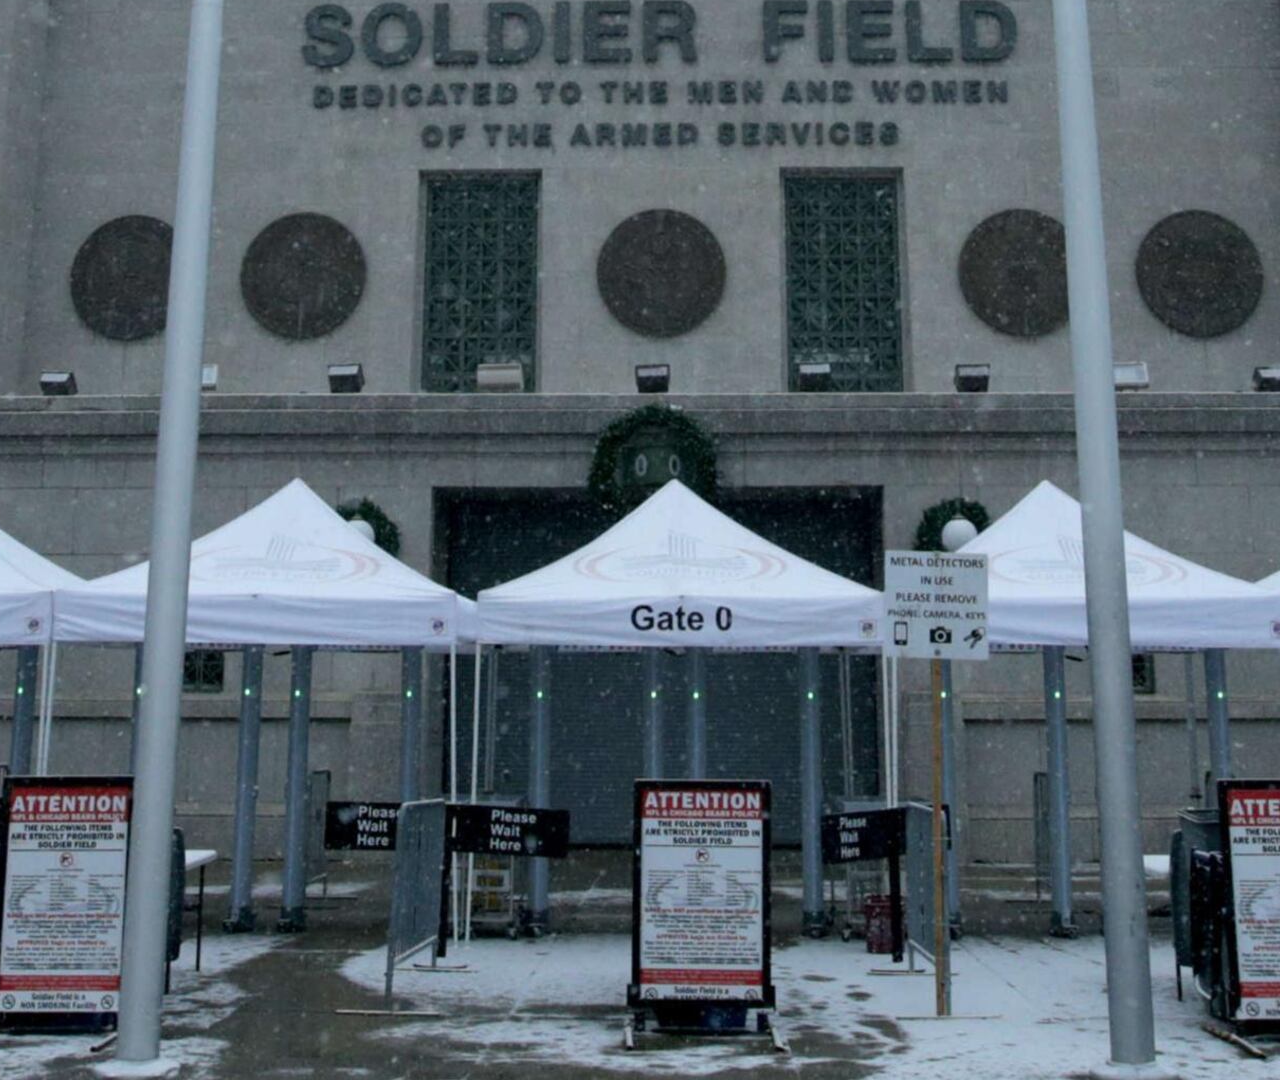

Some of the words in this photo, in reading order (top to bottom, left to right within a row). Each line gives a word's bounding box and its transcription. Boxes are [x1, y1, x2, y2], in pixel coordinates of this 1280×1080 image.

[301, 0, 698, 68] SOLDIER
[762, 0, 1018, 65] FIELD
[313, 82, 517, 109] DEDICATED
[535, 81, 582, 105] TO
[600, 81, 668, 104] THE
[687, 80, 763, 105] MEN
[782, 80, 854, 104] AND
[871, 80, 1008, 104] WOMEN
[420, 124, 465, 149] OF
[483, 123, 552, 147] THE
[569, 122, 699, 147] ARMED
[717, 122, 899, 146] SERVICES
[890, 557, 924, 566] METAL
[927, 558, 984, 568] DETECTORS
[920, 576, 931, 585] IN
[935, 576, 953, 585] USE
[896, 592, 930, 602] PLEASE
[934, 593, 977, 604] REMOVE
[631, 605, 704, 631] Gate
[715, 606, 732, 631] 0
[965, 611, 986, 620] KEYS
[12, 795, 126, 812] ATTENTION
[644, 792, 760, 809] ATTENTION
[491, 809, 537, 824] Please
[840, 816, 867, 829] Please
[357, 820, 388, 832] Wait
[490, 824, 520, 837] Wait
[645, 829, 661, 837] ARE
[663, 829, 699, 837] STRICTLY
[701, 829, 749, 837] PROHIBITED
[751, 829, 761, 837] IN
[840, 831, 859, 843] Wait
[357, 834, 389, 846] Here
[489, 837, 521, 851] Here
[840, 845, 860, 859] Here
